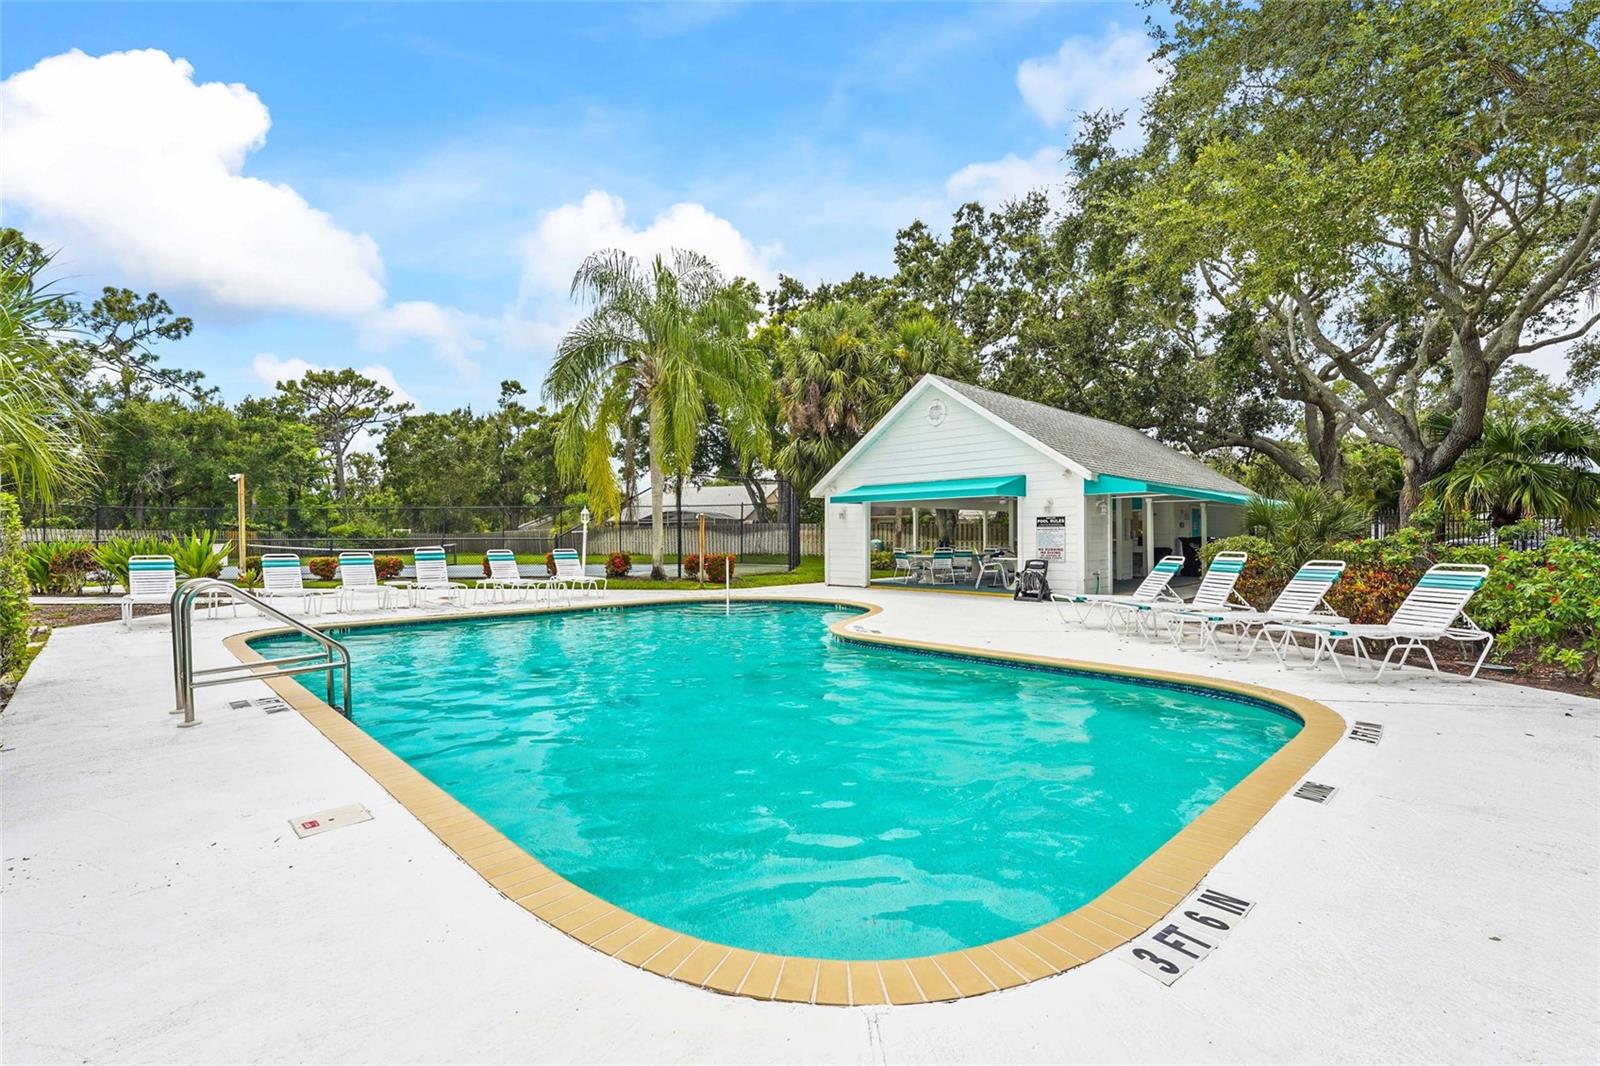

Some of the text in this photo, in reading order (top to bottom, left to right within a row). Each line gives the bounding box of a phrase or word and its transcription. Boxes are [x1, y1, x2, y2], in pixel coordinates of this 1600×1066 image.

[1132, 888, 1250, 974] 3 FT 6 IN
